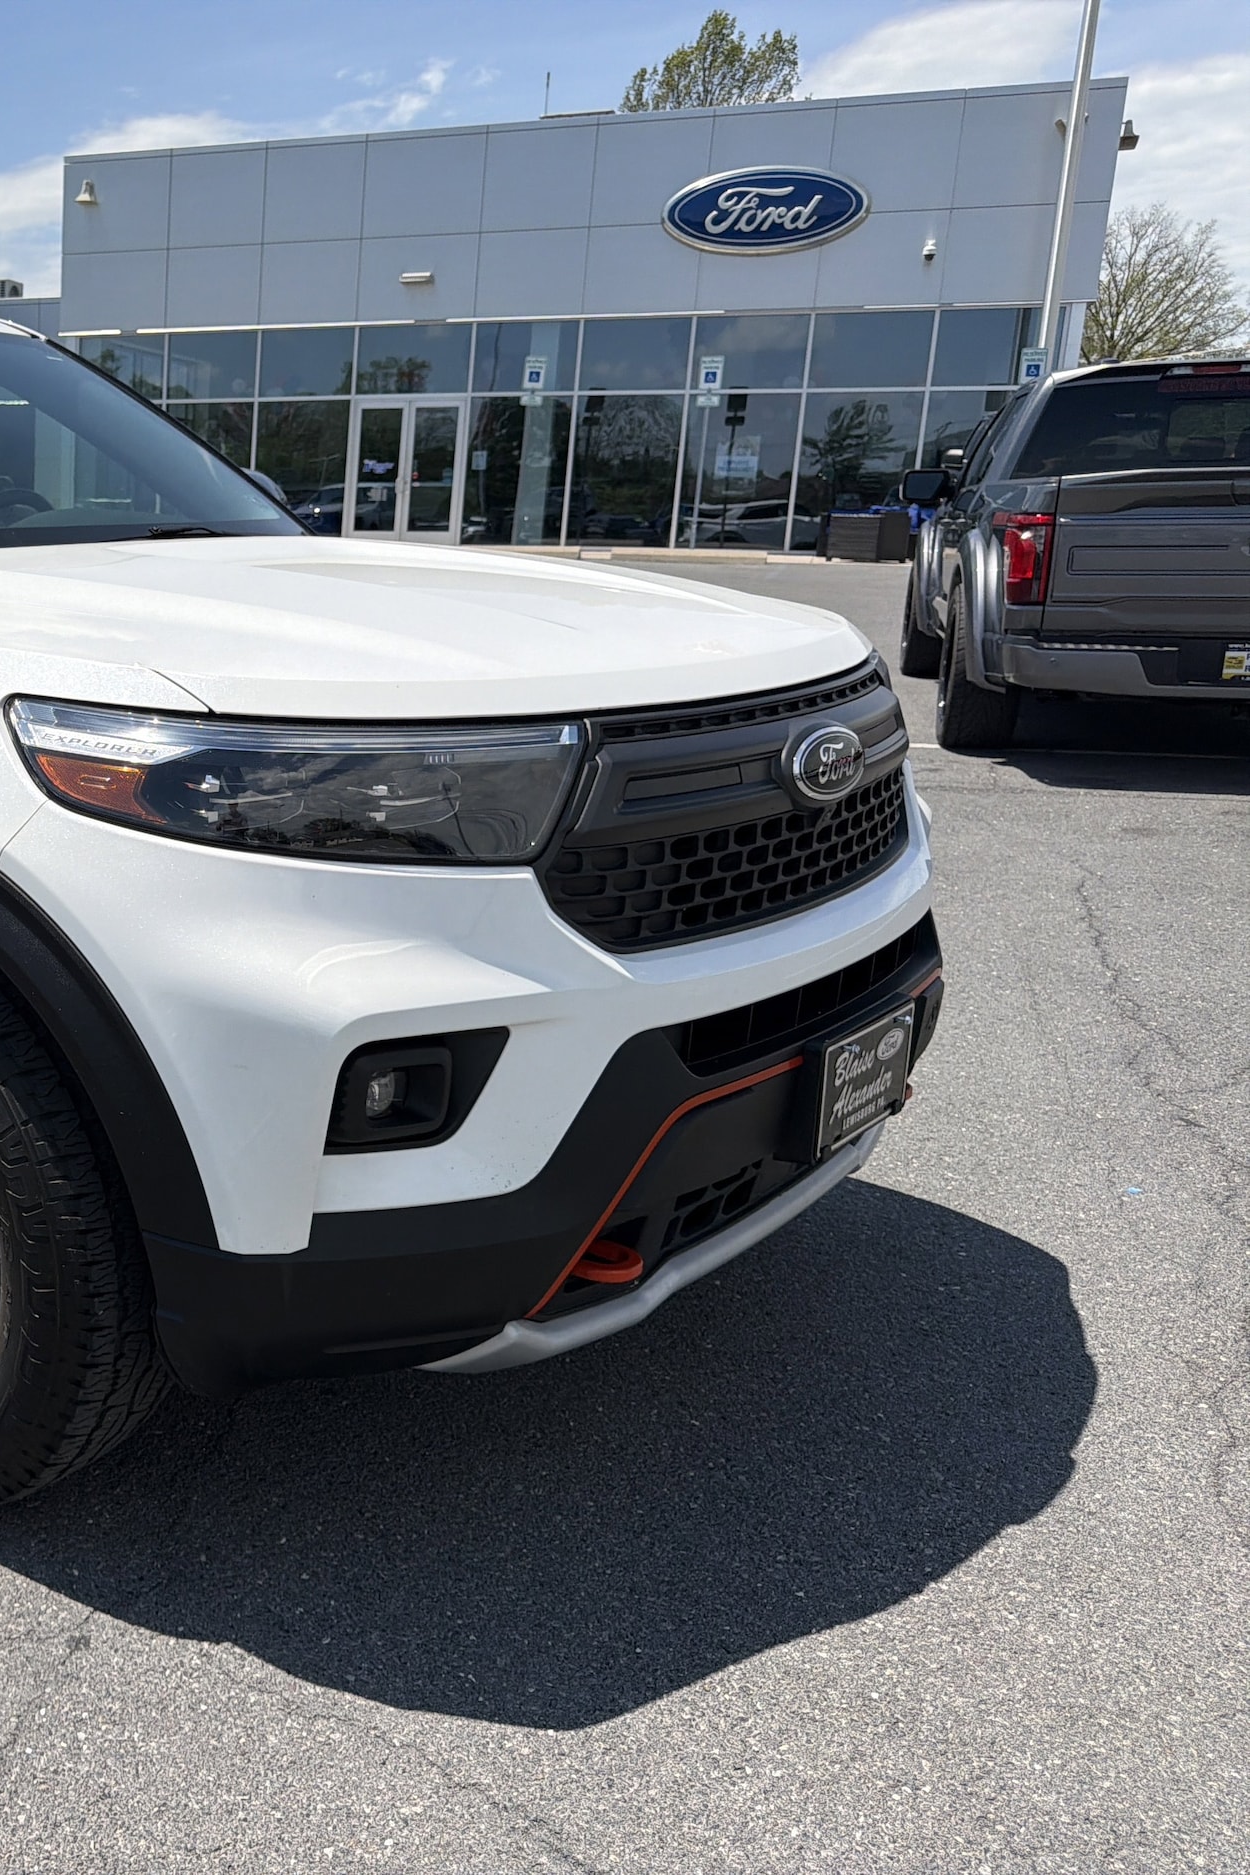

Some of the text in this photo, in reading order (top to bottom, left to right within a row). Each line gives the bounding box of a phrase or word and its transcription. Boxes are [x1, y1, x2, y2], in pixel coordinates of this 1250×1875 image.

[704, 186, 823, 234] Ford
[41, 732, 158, 756] EXPLORER
[818, 742, 856, 784] Ford
[834, 1050, 875, 1087] Blaise
[829, 1066, 892, 1126] Alexander
[842, 1100, 877, 1131] LEWISBURG
